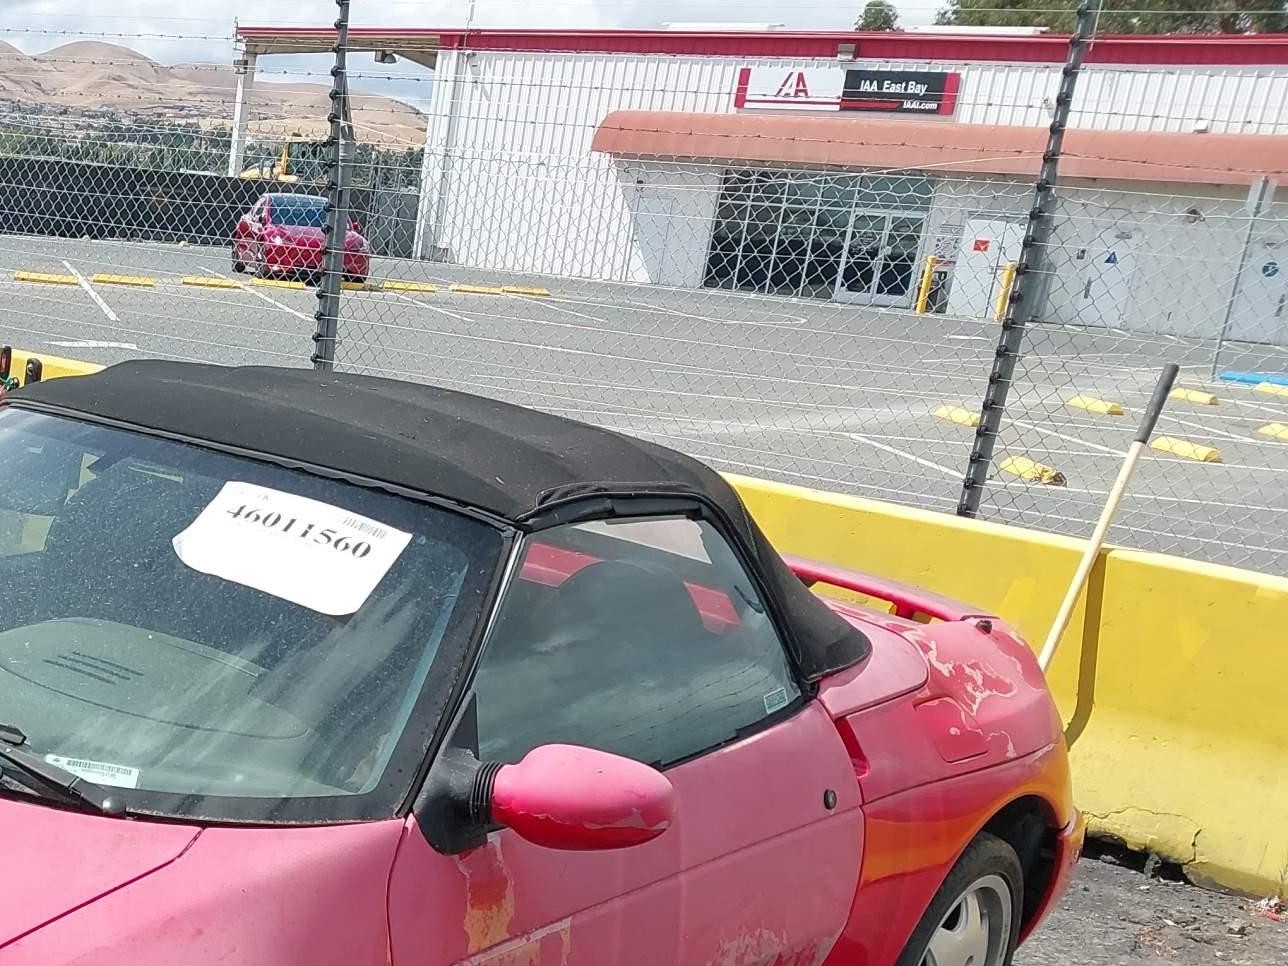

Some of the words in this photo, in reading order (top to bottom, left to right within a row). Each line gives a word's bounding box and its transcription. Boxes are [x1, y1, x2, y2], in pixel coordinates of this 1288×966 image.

[860, 79, 878, 92] IAA
[883, 80, 906, 93] East
[907, 80, 928, 96] Bay
[226, 504, 372, 559] 46011560
